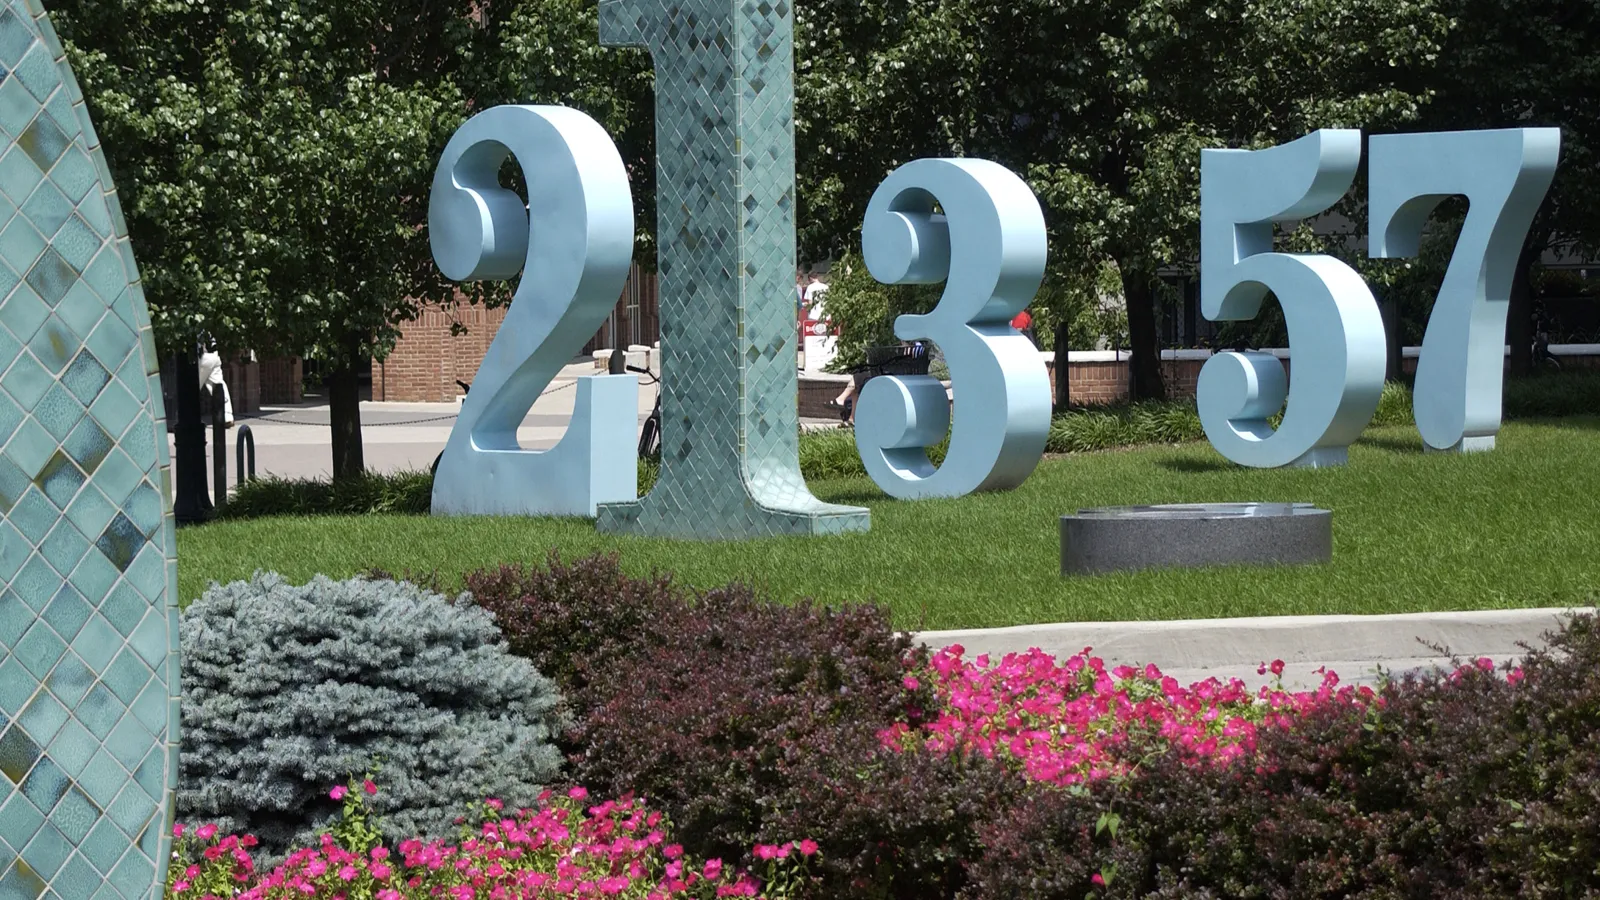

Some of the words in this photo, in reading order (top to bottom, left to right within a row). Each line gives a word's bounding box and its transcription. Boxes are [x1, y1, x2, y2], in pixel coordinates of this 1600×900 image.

[428, 104, 635, 516] 2
[598, 0, 871, 541] 1
[855, 158, 1052, 500] 3
[1196, 128, 1387, 468] 5
[1368, 127, 1560, 450] 7
